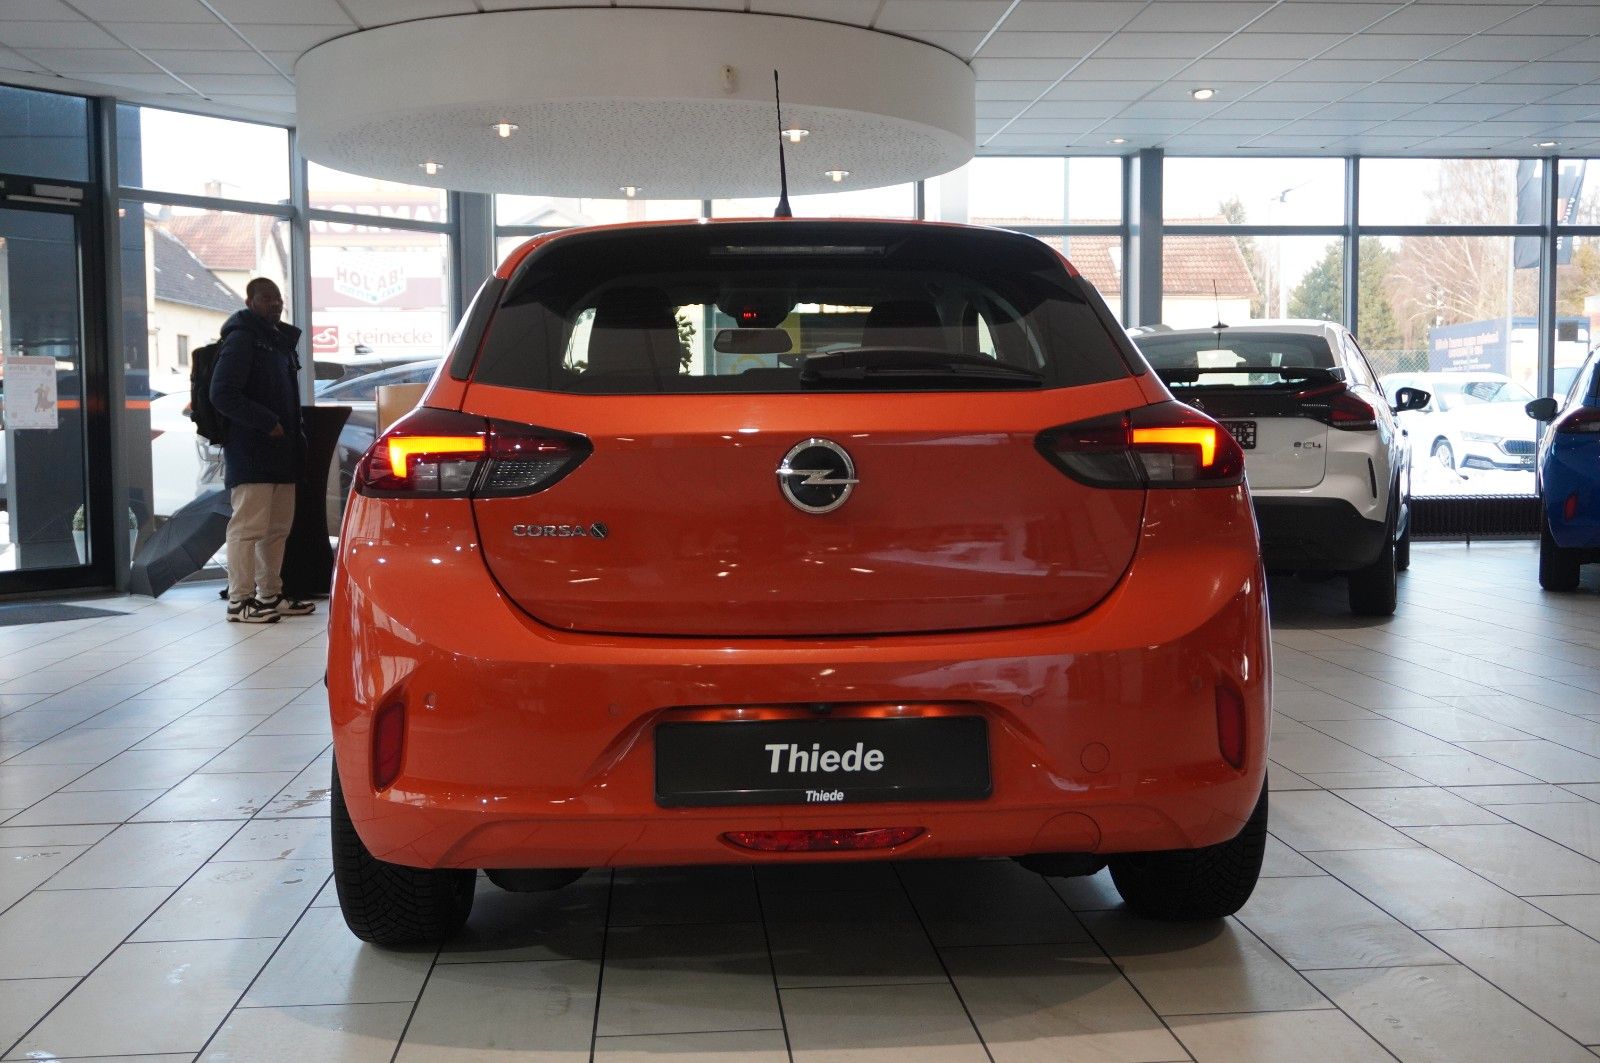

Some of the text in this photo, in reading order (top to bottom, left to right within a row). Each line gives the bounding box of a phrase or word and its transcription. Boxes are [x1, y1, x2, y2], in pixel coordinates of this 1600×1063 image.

[347, 328, 432, 344] steinecke
[512, 524, 587, 537] CORSA
[764, 742, 885, 773] Thiede
[805, 789, 844, 802] Thiede
